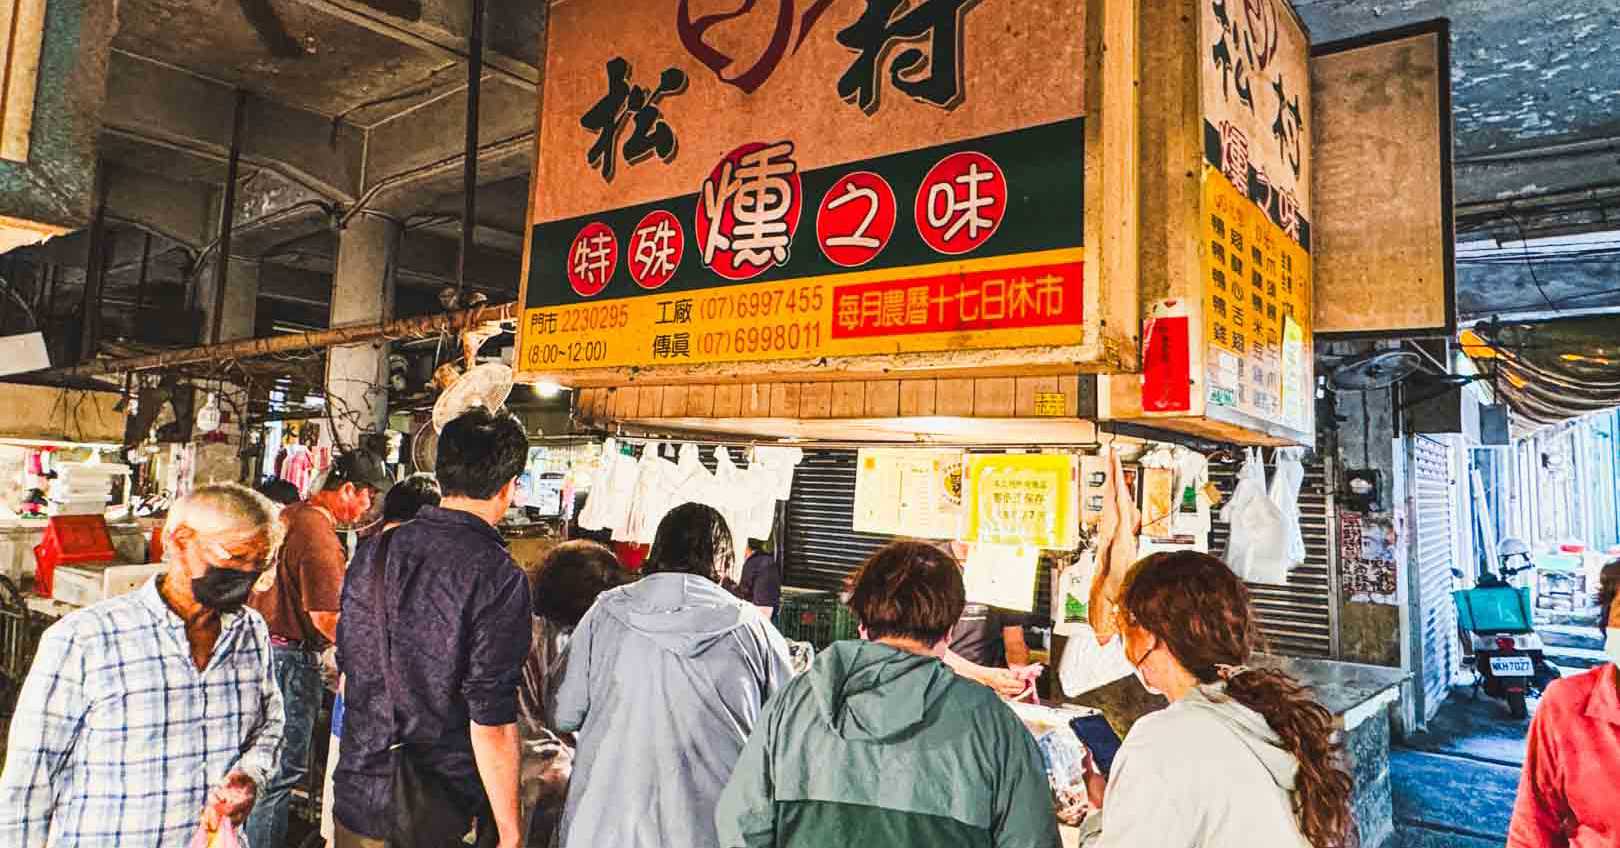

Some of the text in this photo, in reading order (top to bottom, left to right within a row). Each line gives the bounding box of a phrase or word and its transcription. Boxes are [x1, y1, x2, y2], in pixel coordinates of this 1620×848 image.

[580, 56, 689, 182] 松
[531, 304, 629, 336] 門市 2230295
[655, 299, 692, 325] 工廠
[838, 274, 1064, 331] 每月農曆十七日休市
